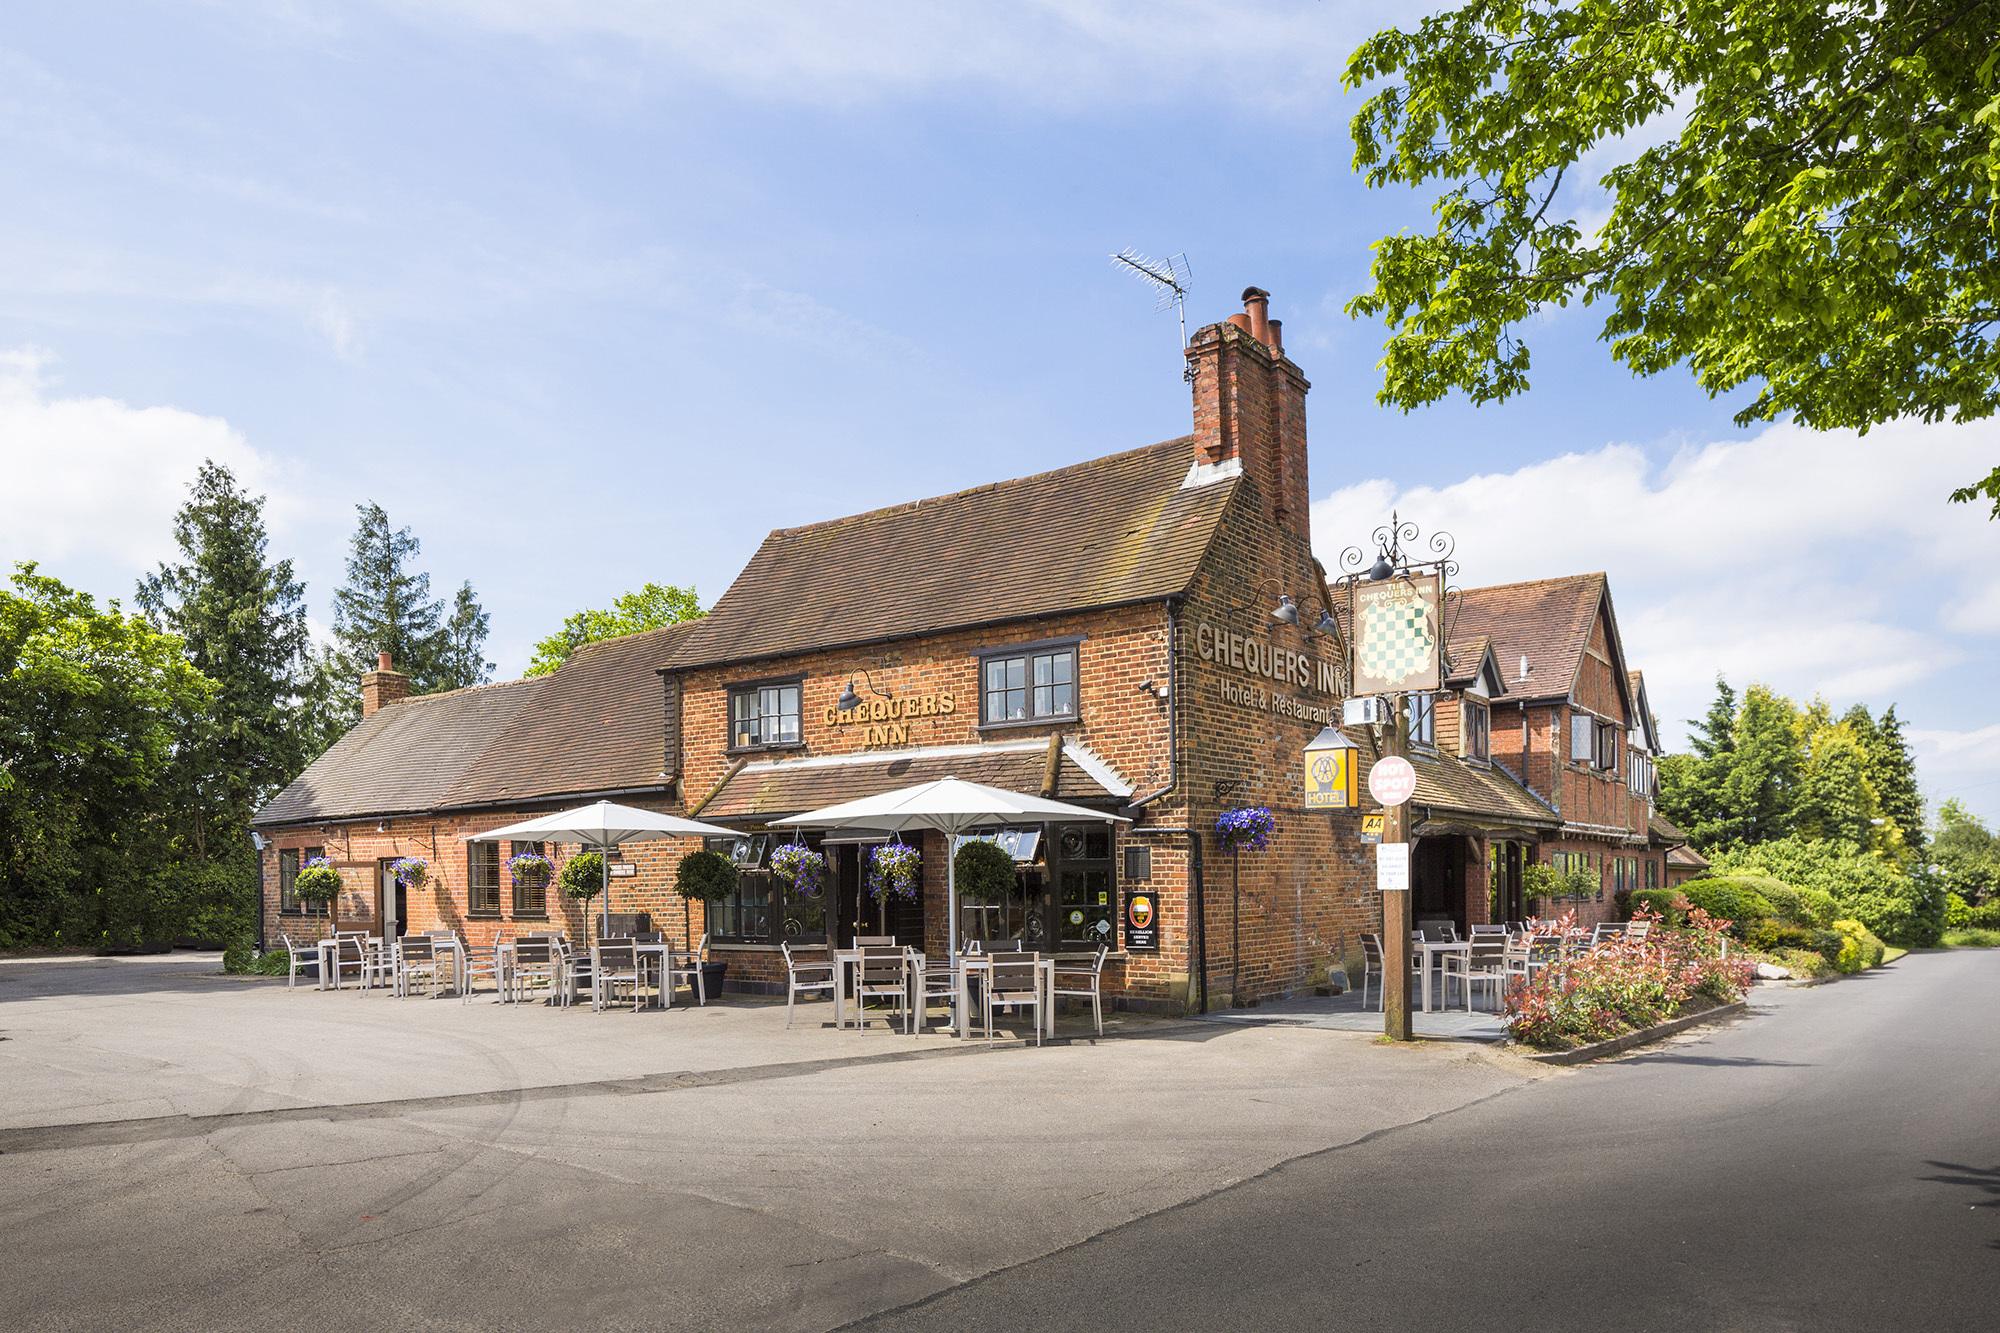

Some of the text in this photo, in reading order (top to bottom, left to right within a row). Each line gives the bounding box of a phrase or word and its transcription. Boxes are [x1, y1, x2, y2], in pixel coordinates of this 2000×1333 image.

[1360, 585, 1433, 602] CHEQUERS INN
[1196, 622, 1345, 698] CHEQUERS INN
[822, 691, 956, 727] CHEQUERS
[1220, 677, 1333, 724] Hotel & Restaurant
[862, 722, 910, 747] INN
[1375, 777, 1410, 791] SPOT
[1307, 791, 1344, 804] HOTEL
[1365, 817, 1382, 829] AA
